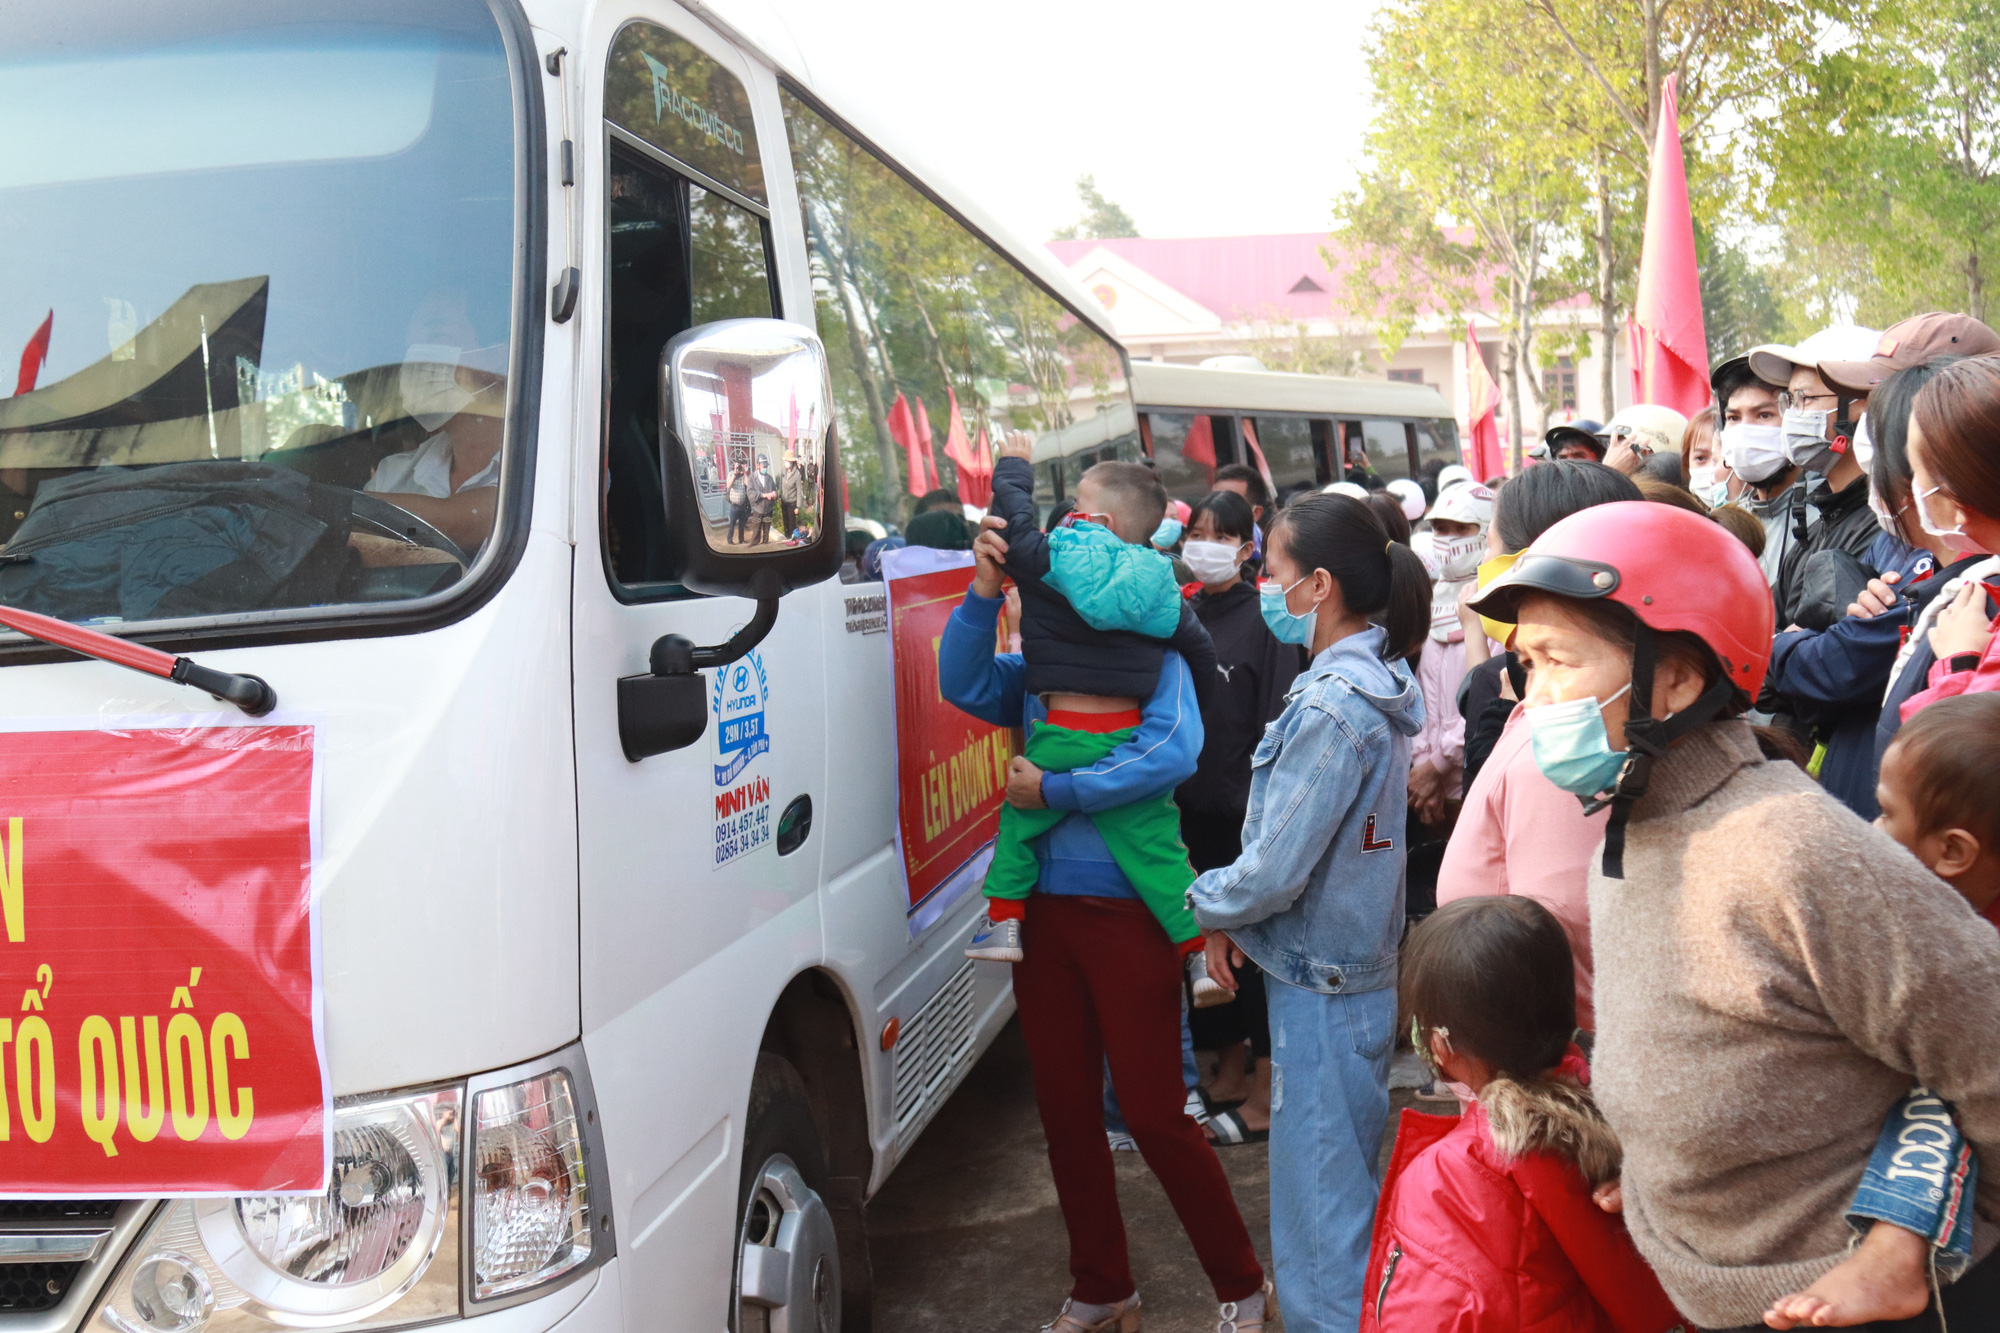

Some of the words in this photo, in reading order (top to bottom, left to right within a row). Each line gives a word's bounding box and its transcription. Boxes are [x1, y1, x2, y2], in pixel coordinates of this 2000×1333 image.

[640, 50, 744, 155] TRACOMECO
[727, 694, 756, 713] HYUNDAI
[725, 723, 739, 744] 29N
[715, 785, 746, 822] MINH
[747, 775, 770, 807] VÂN
[921, 750, 950, 844] LÊN
[950, 729, 993, 823] ĐƯỜNG
[715, 804, 770, 844] 0914.457.447
[1361, 813, 1394, 854] L
[78, 966, 254, 1158] QUỐC
